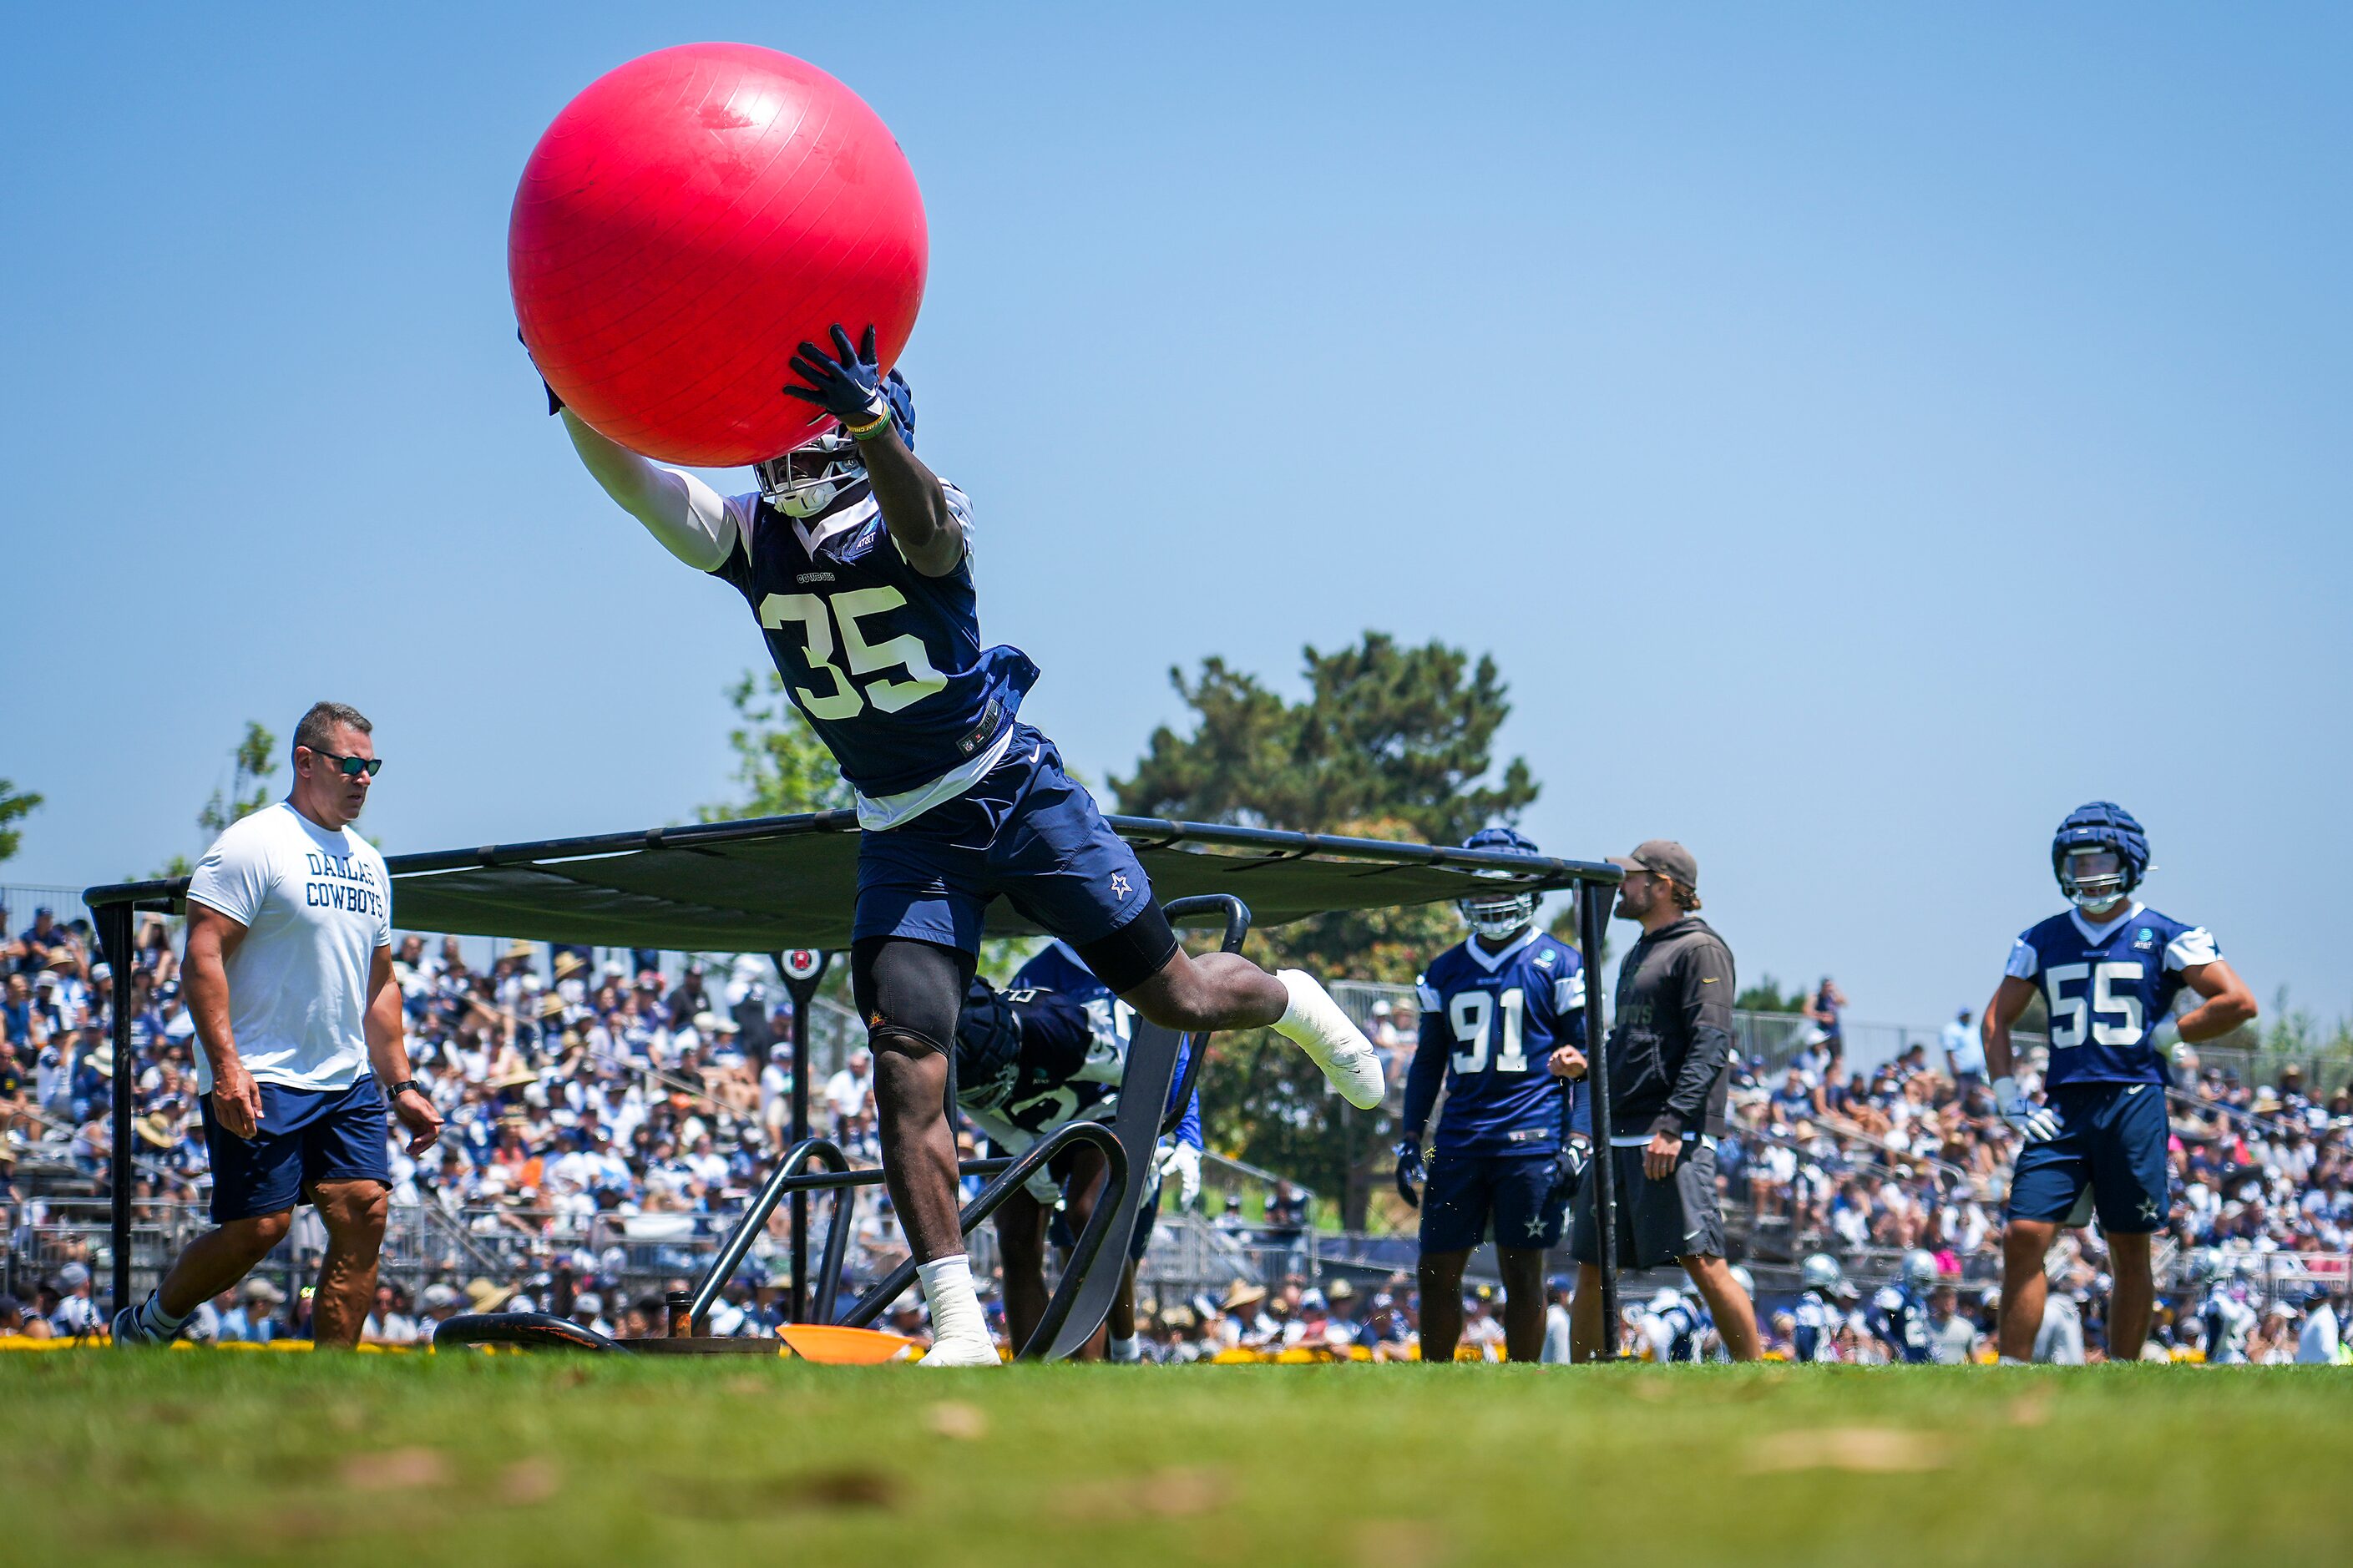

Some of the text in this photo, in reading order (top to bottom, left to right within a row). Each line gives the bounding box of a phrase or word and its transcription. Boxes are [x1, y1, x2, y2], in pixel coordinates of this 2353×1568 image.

[855, 532, 876, 550] AT&T
[797, 572, 836, 584] COWBOYS
[759, 584, 949, 721] 35
[306, 853, 375, 887] DALLAS
[306, 882, 383, 919] COWBOYS
[2046, 962, 2143, 1049] 55
[1450, 988, 1527, 1075] 91
